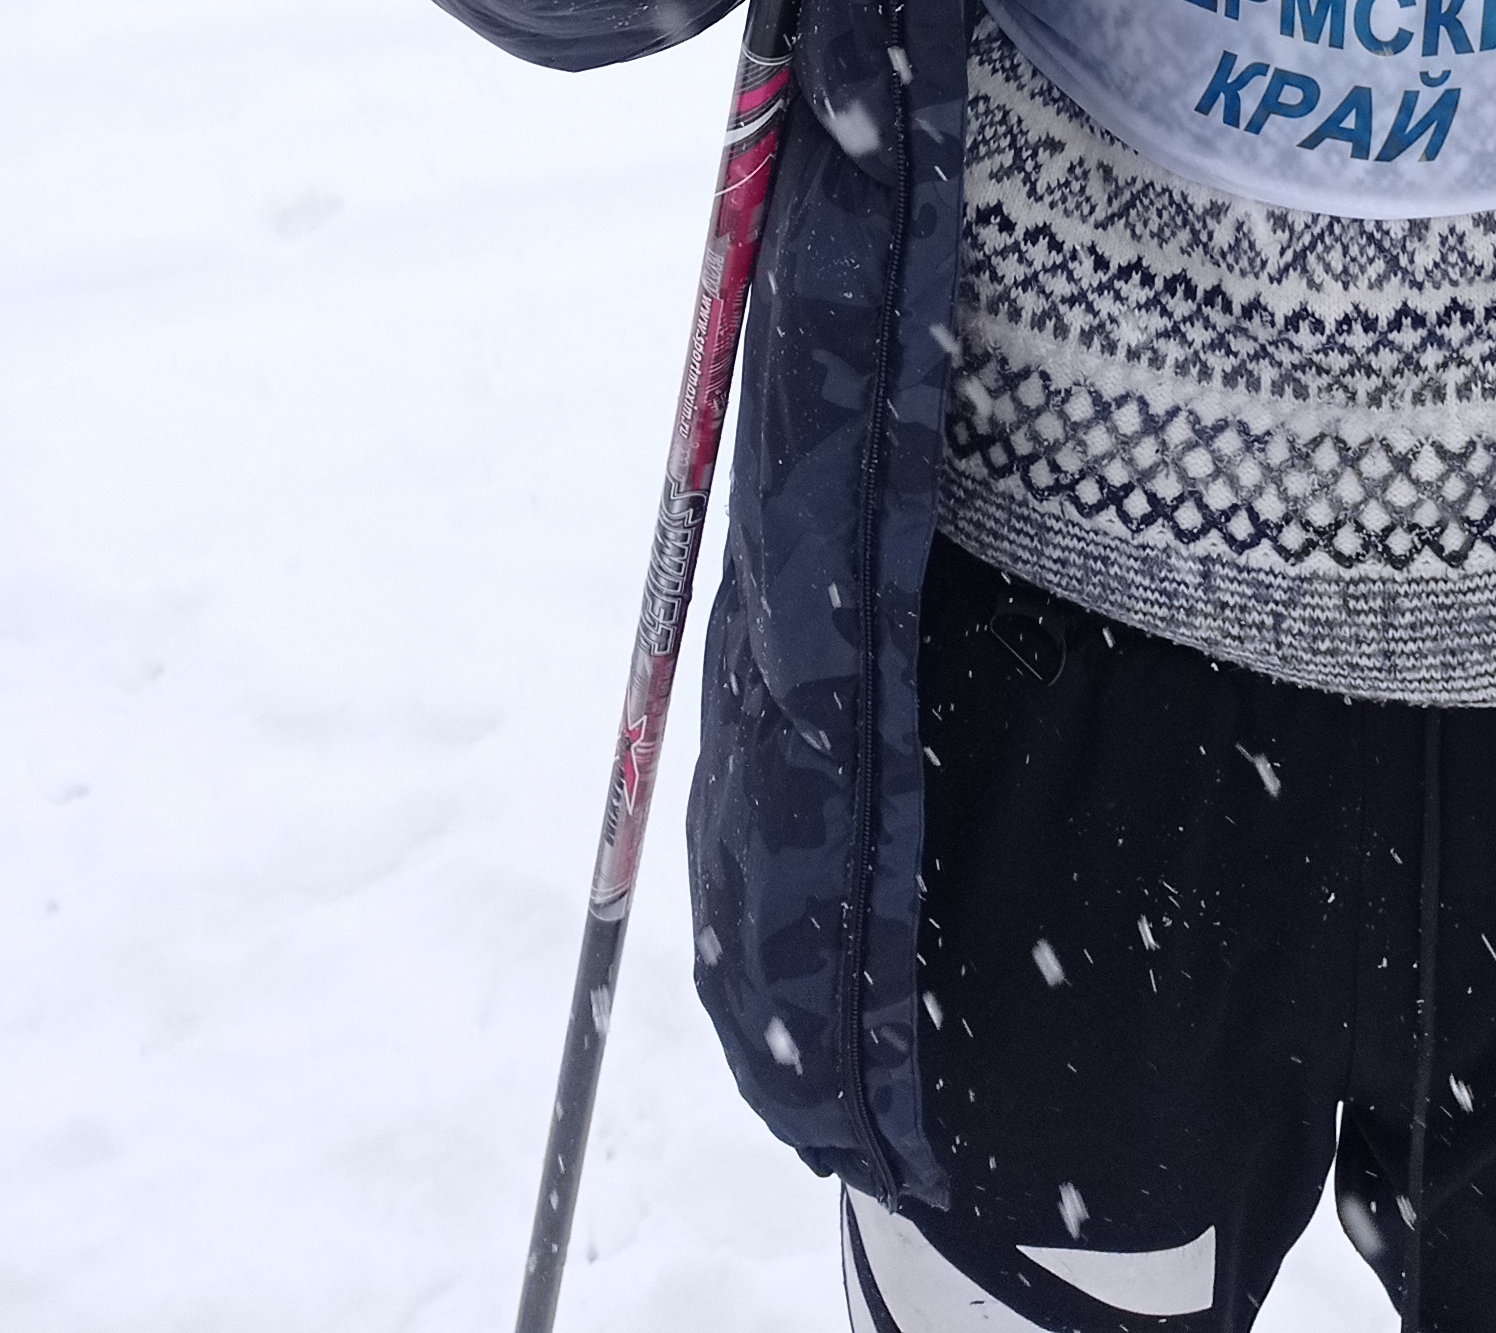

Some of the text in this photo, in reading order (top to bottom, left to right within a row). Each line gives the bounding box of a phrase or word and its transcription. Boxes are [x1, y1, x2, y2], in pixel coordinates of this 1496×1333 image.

[1194, 49, 1462, 163] КРАЙ
[679, 294, 713, 439] www.sportmaxim.ru
[637, 473, 709, 656] SWIFT
